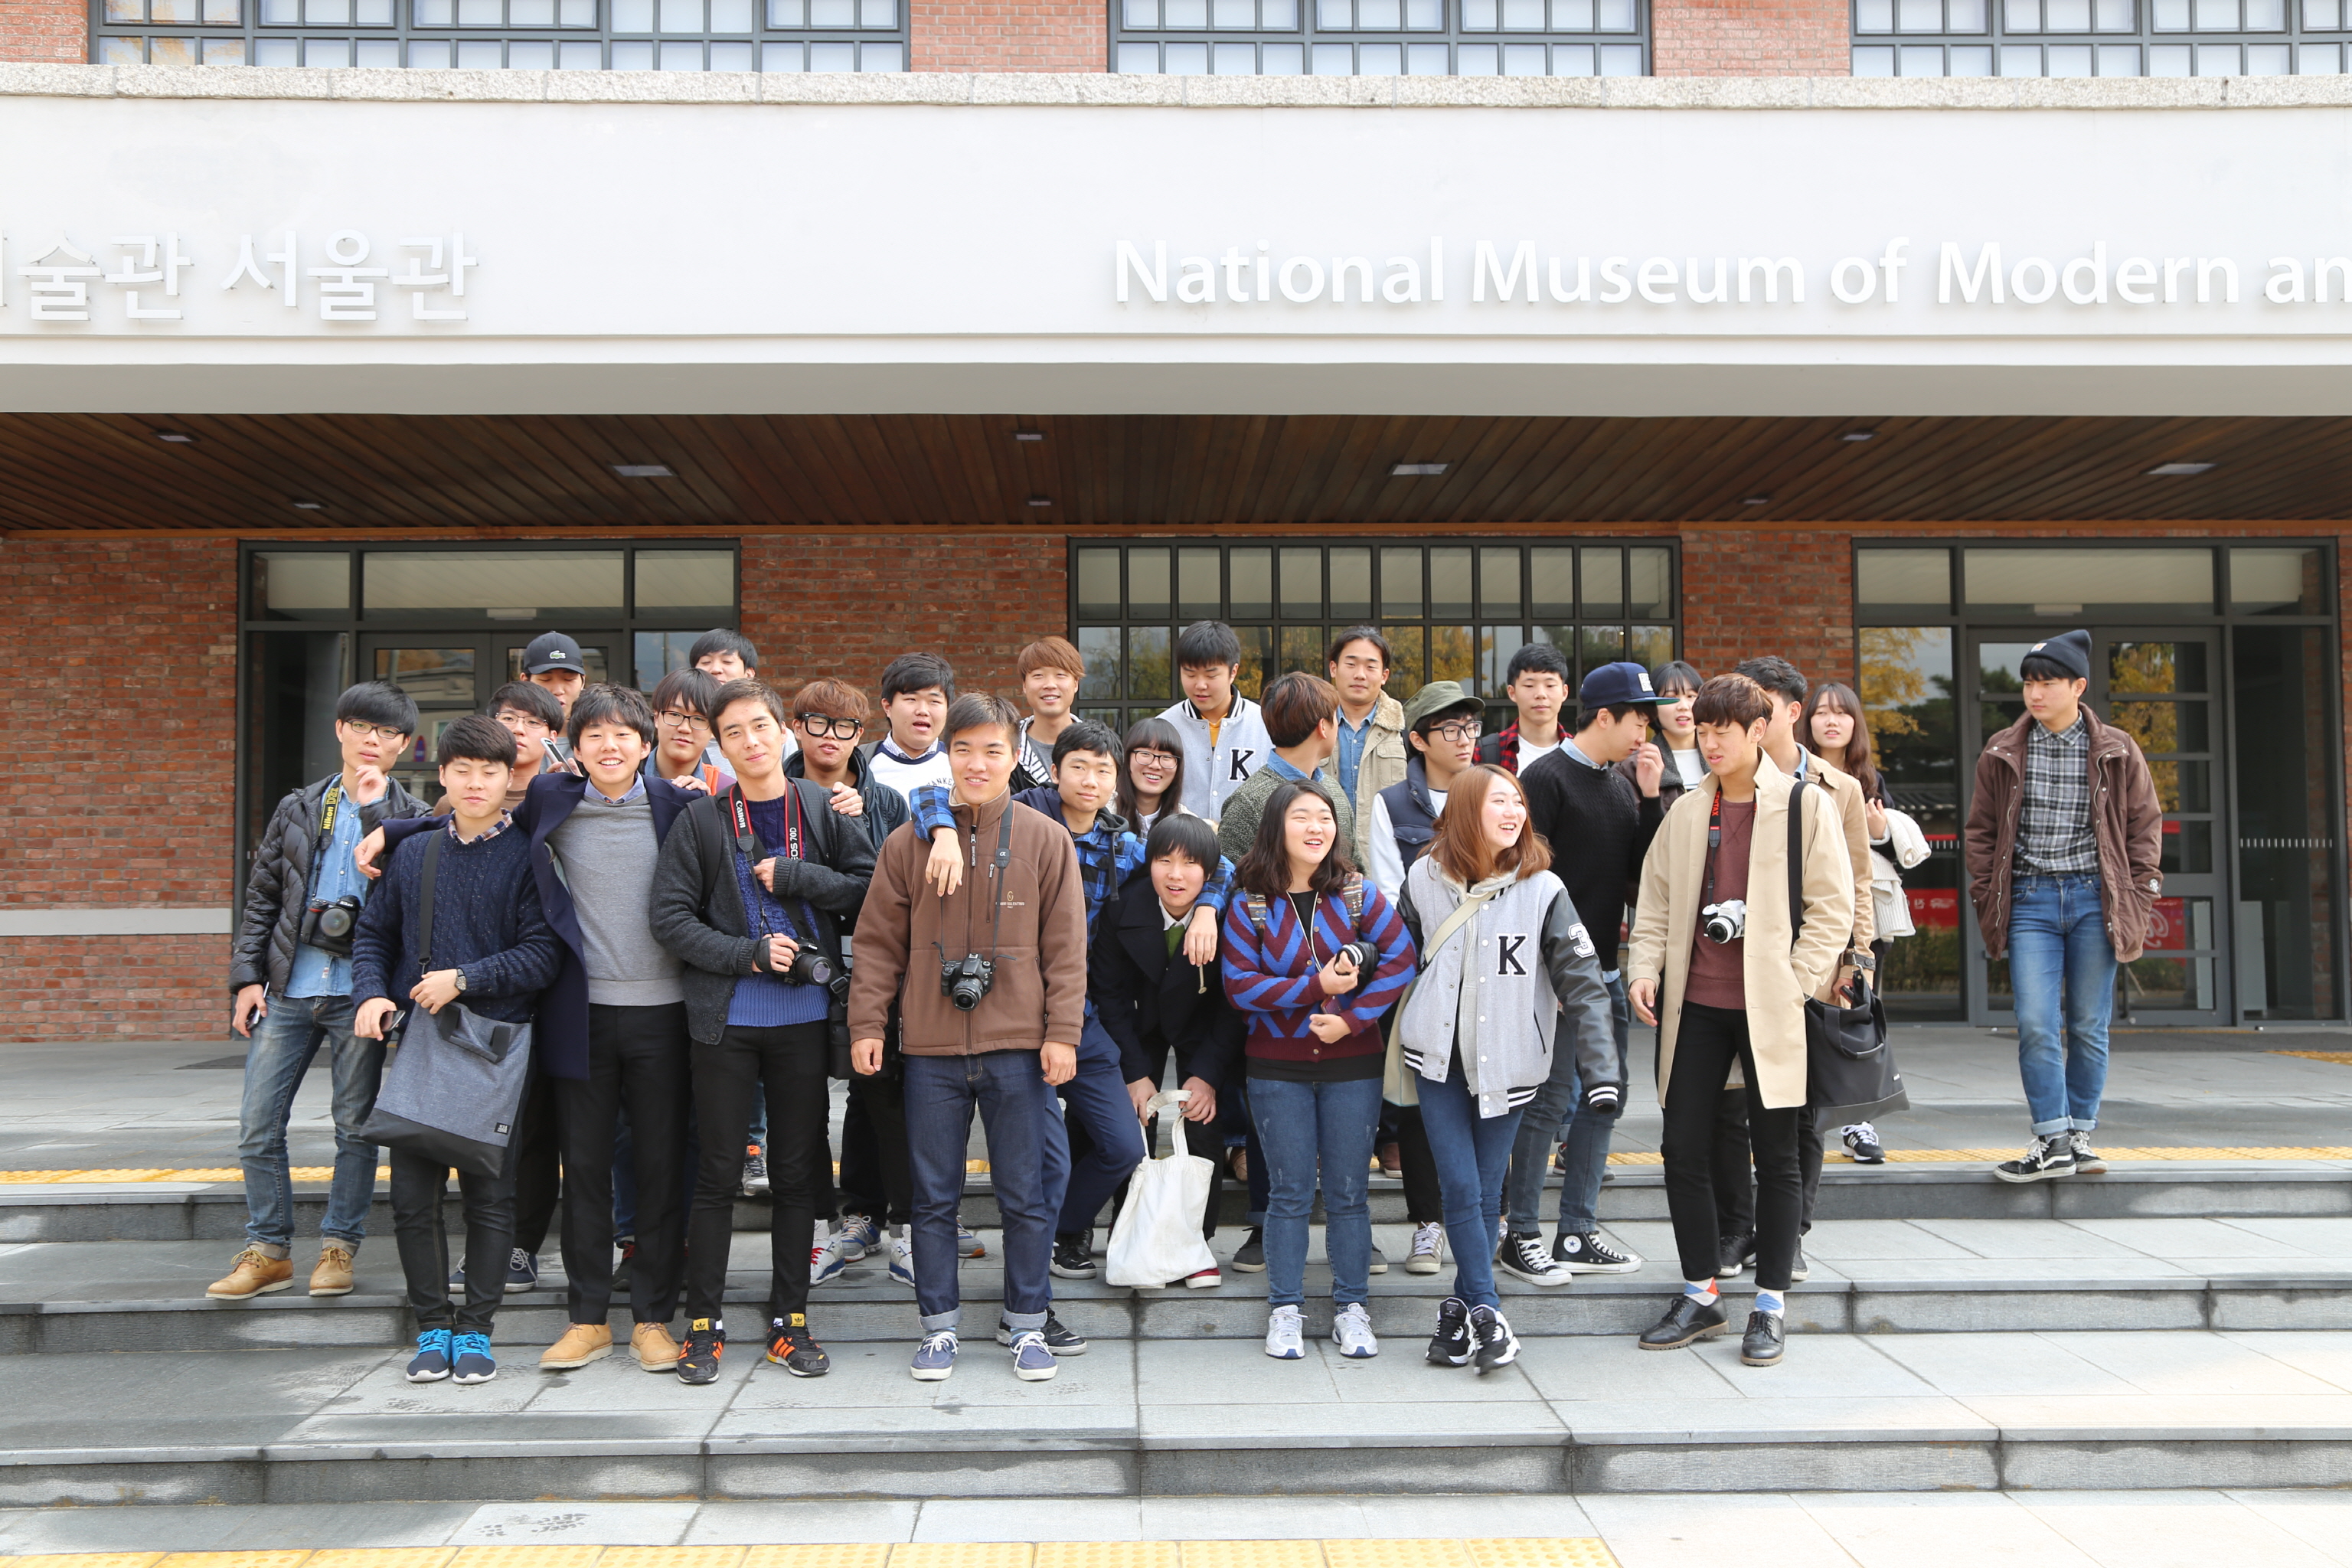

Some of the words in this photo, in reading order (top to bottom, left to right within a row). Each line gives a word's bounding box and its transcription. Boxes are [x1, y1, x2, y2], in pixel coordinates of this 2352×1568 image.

[0, 230, 193, 321] 술관
[220, 230, 477, 321] 서울관
[1116, 236, 1444, 305] National
[1472, 239, 1805, 305] Museum
[1829, 236, 1910, 305] of
[1938, 240, 2240, 305] Modern
[1230, 749, 1254, 781] K
[322, 806, 334, 830] Nikon
[735, 800, 746, 828] Canon
[789, 827, 798, 841] 70D
[1498, 936, 1527, 975] K
[1568, 922, 1596, 958] 3
